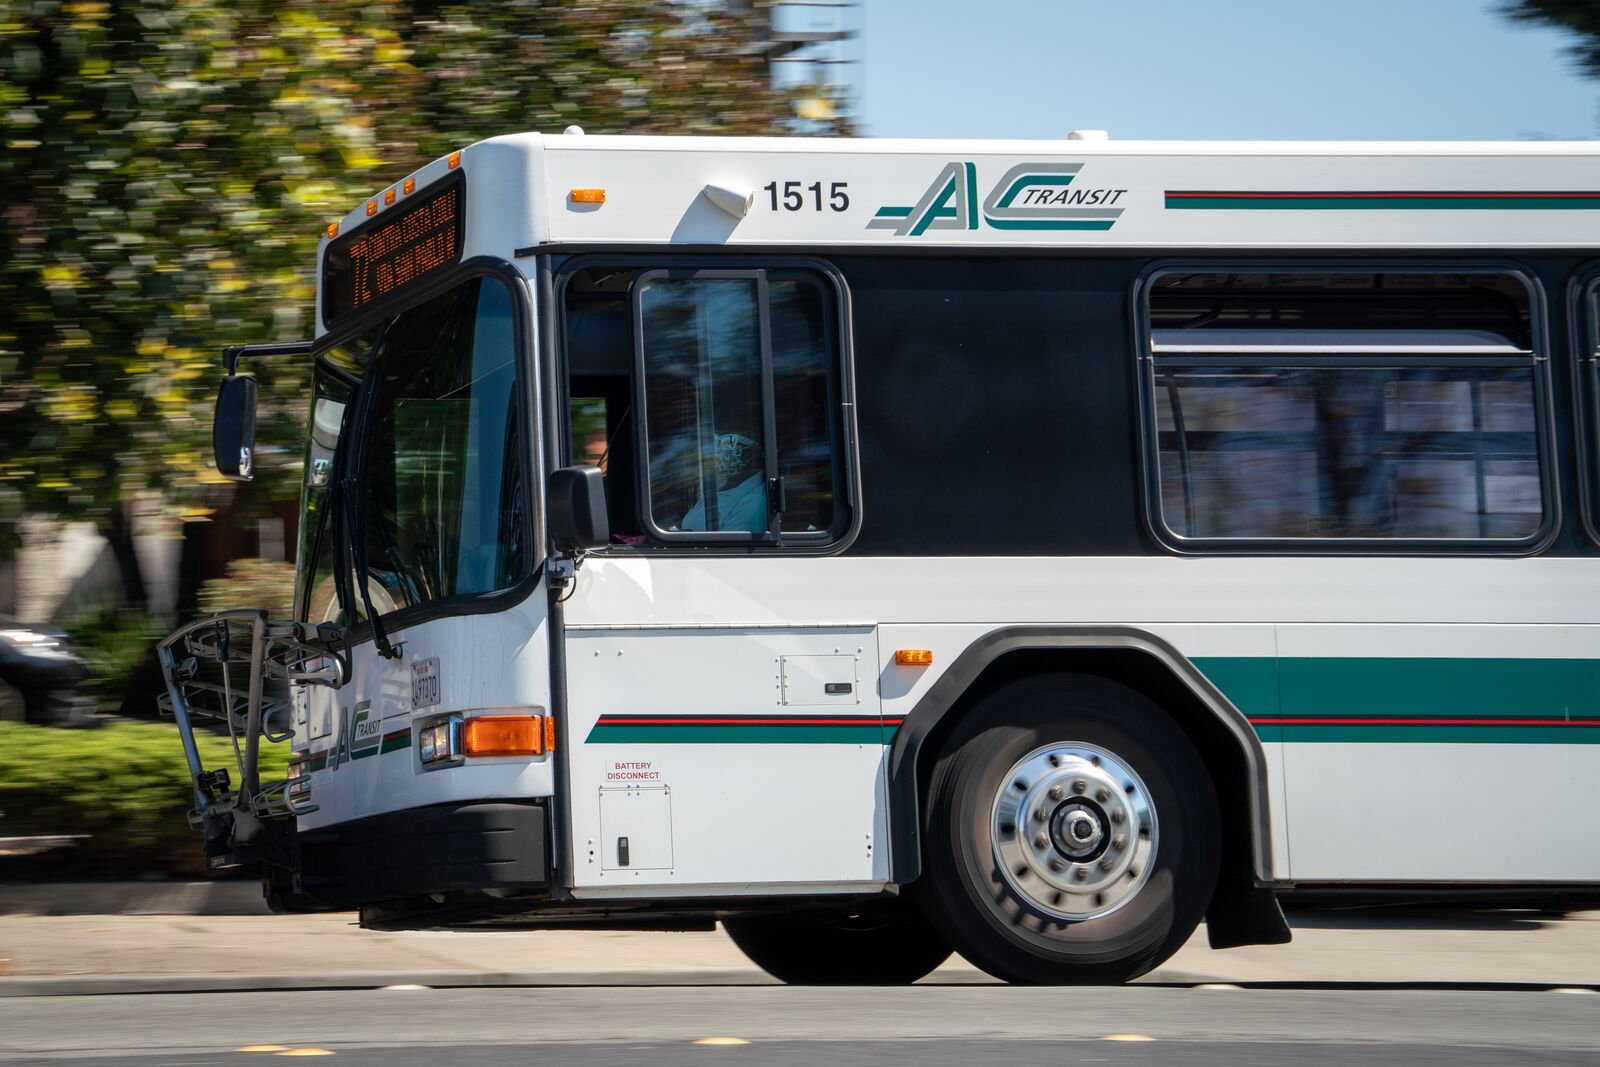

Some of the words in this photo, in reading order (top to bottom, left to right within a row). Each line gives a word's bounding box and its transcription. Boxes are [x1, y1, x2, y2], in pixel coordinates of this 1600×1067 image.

[763, 181, 849, 212] 1515
[865, 162, 1126, 236] AC
[1022, 189, 1128, 205] TRANSIT
[326, 700, 382, 771] AC
[357, 720, 382, 737] TRANSIT
[607, 772, 660, 780] DISCONNECT
[614, 762, 652, 770] BATTERY
